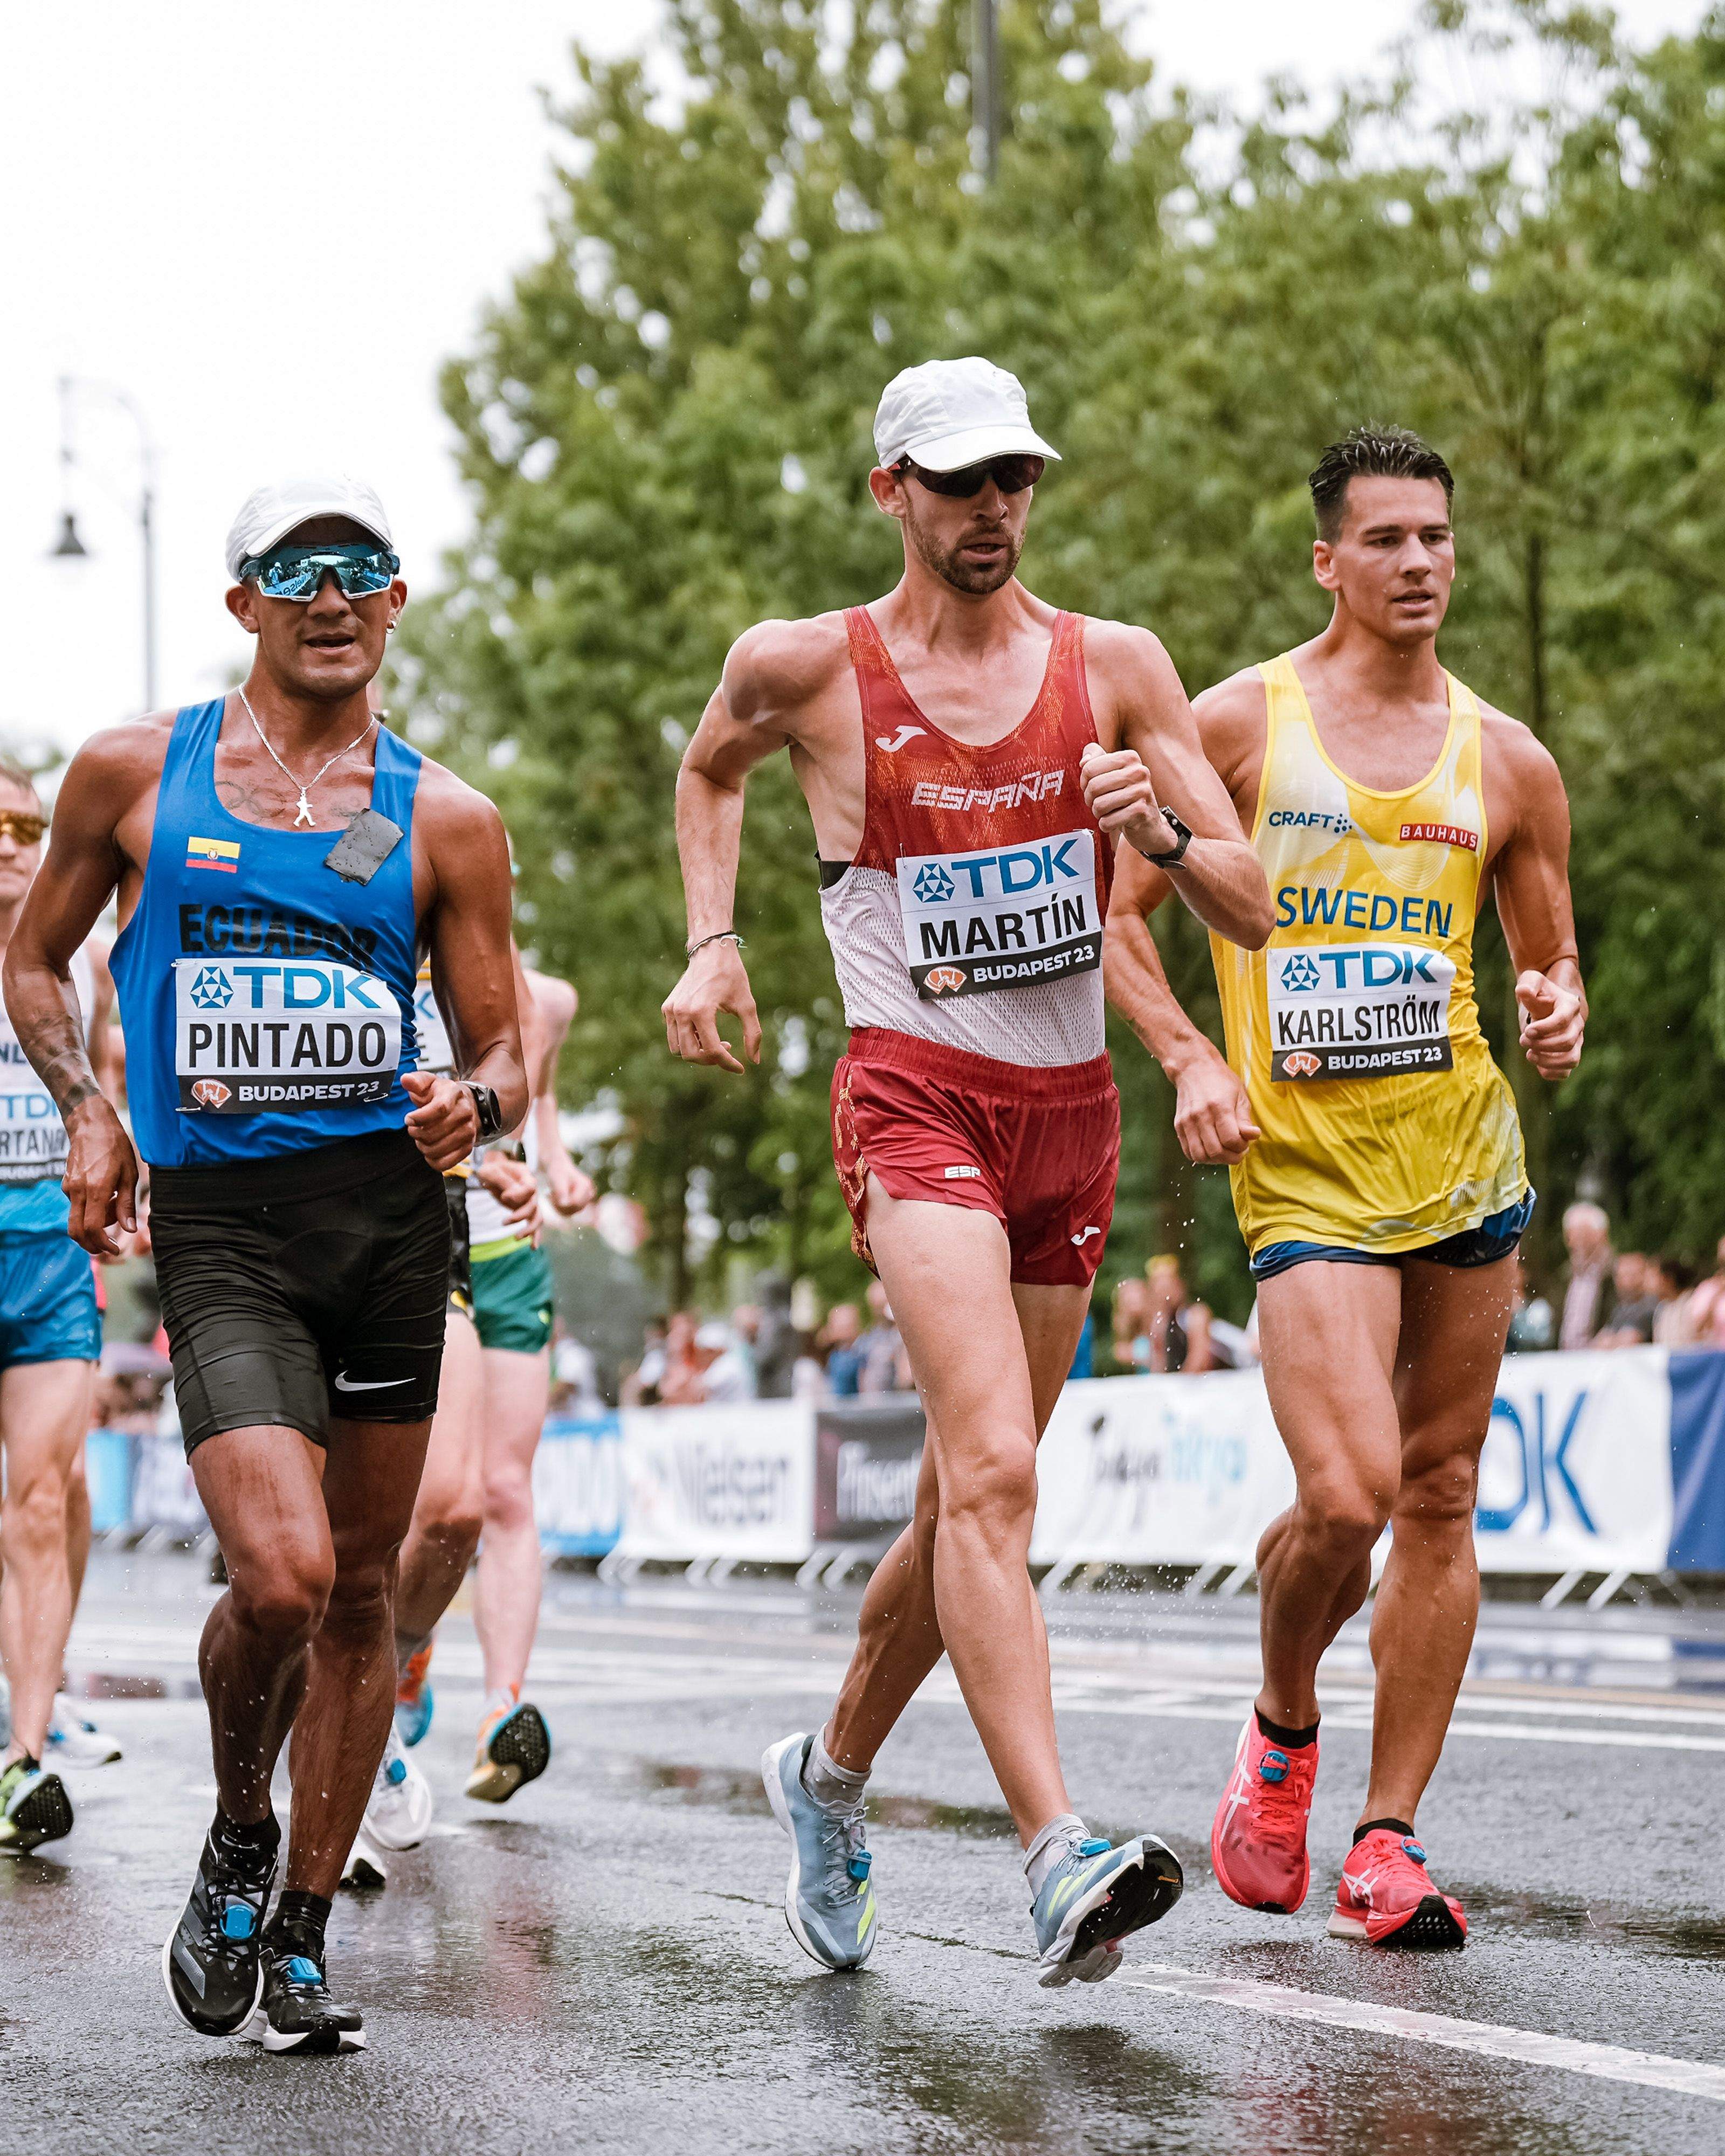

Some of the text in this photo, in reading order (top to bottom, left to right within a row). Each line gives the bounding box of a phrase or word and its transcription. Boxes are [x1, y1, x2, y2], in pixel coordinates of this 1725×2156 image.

[911, 769, 1065, 812] ESPAÑA
[1268, 811, 1334, 828] CRAFT
[1400, 824, 1478, 848] BAUHAUS
[951, 838, 1080, 899] TDK
[920, 892, 1087, 959] MARTÍN
[1275, 886, 1453, 938] SWEDEN
[179, 904, 377, 972] ECUADOR
[973, 944, 1094, 983] BUDAPEST 23
[1319, 950, 1438, 989] TDK
[233, 966, 382, 1009] TDK
[1278, 994, 1441, 1046] KARLSTRÖM
[189, 1022, 387, 1068] PINTADO
[1328, 1047, 1443, 1070] BUDAPEST 23
[239, 1081, 380, 1102] BUDAPEST 23
